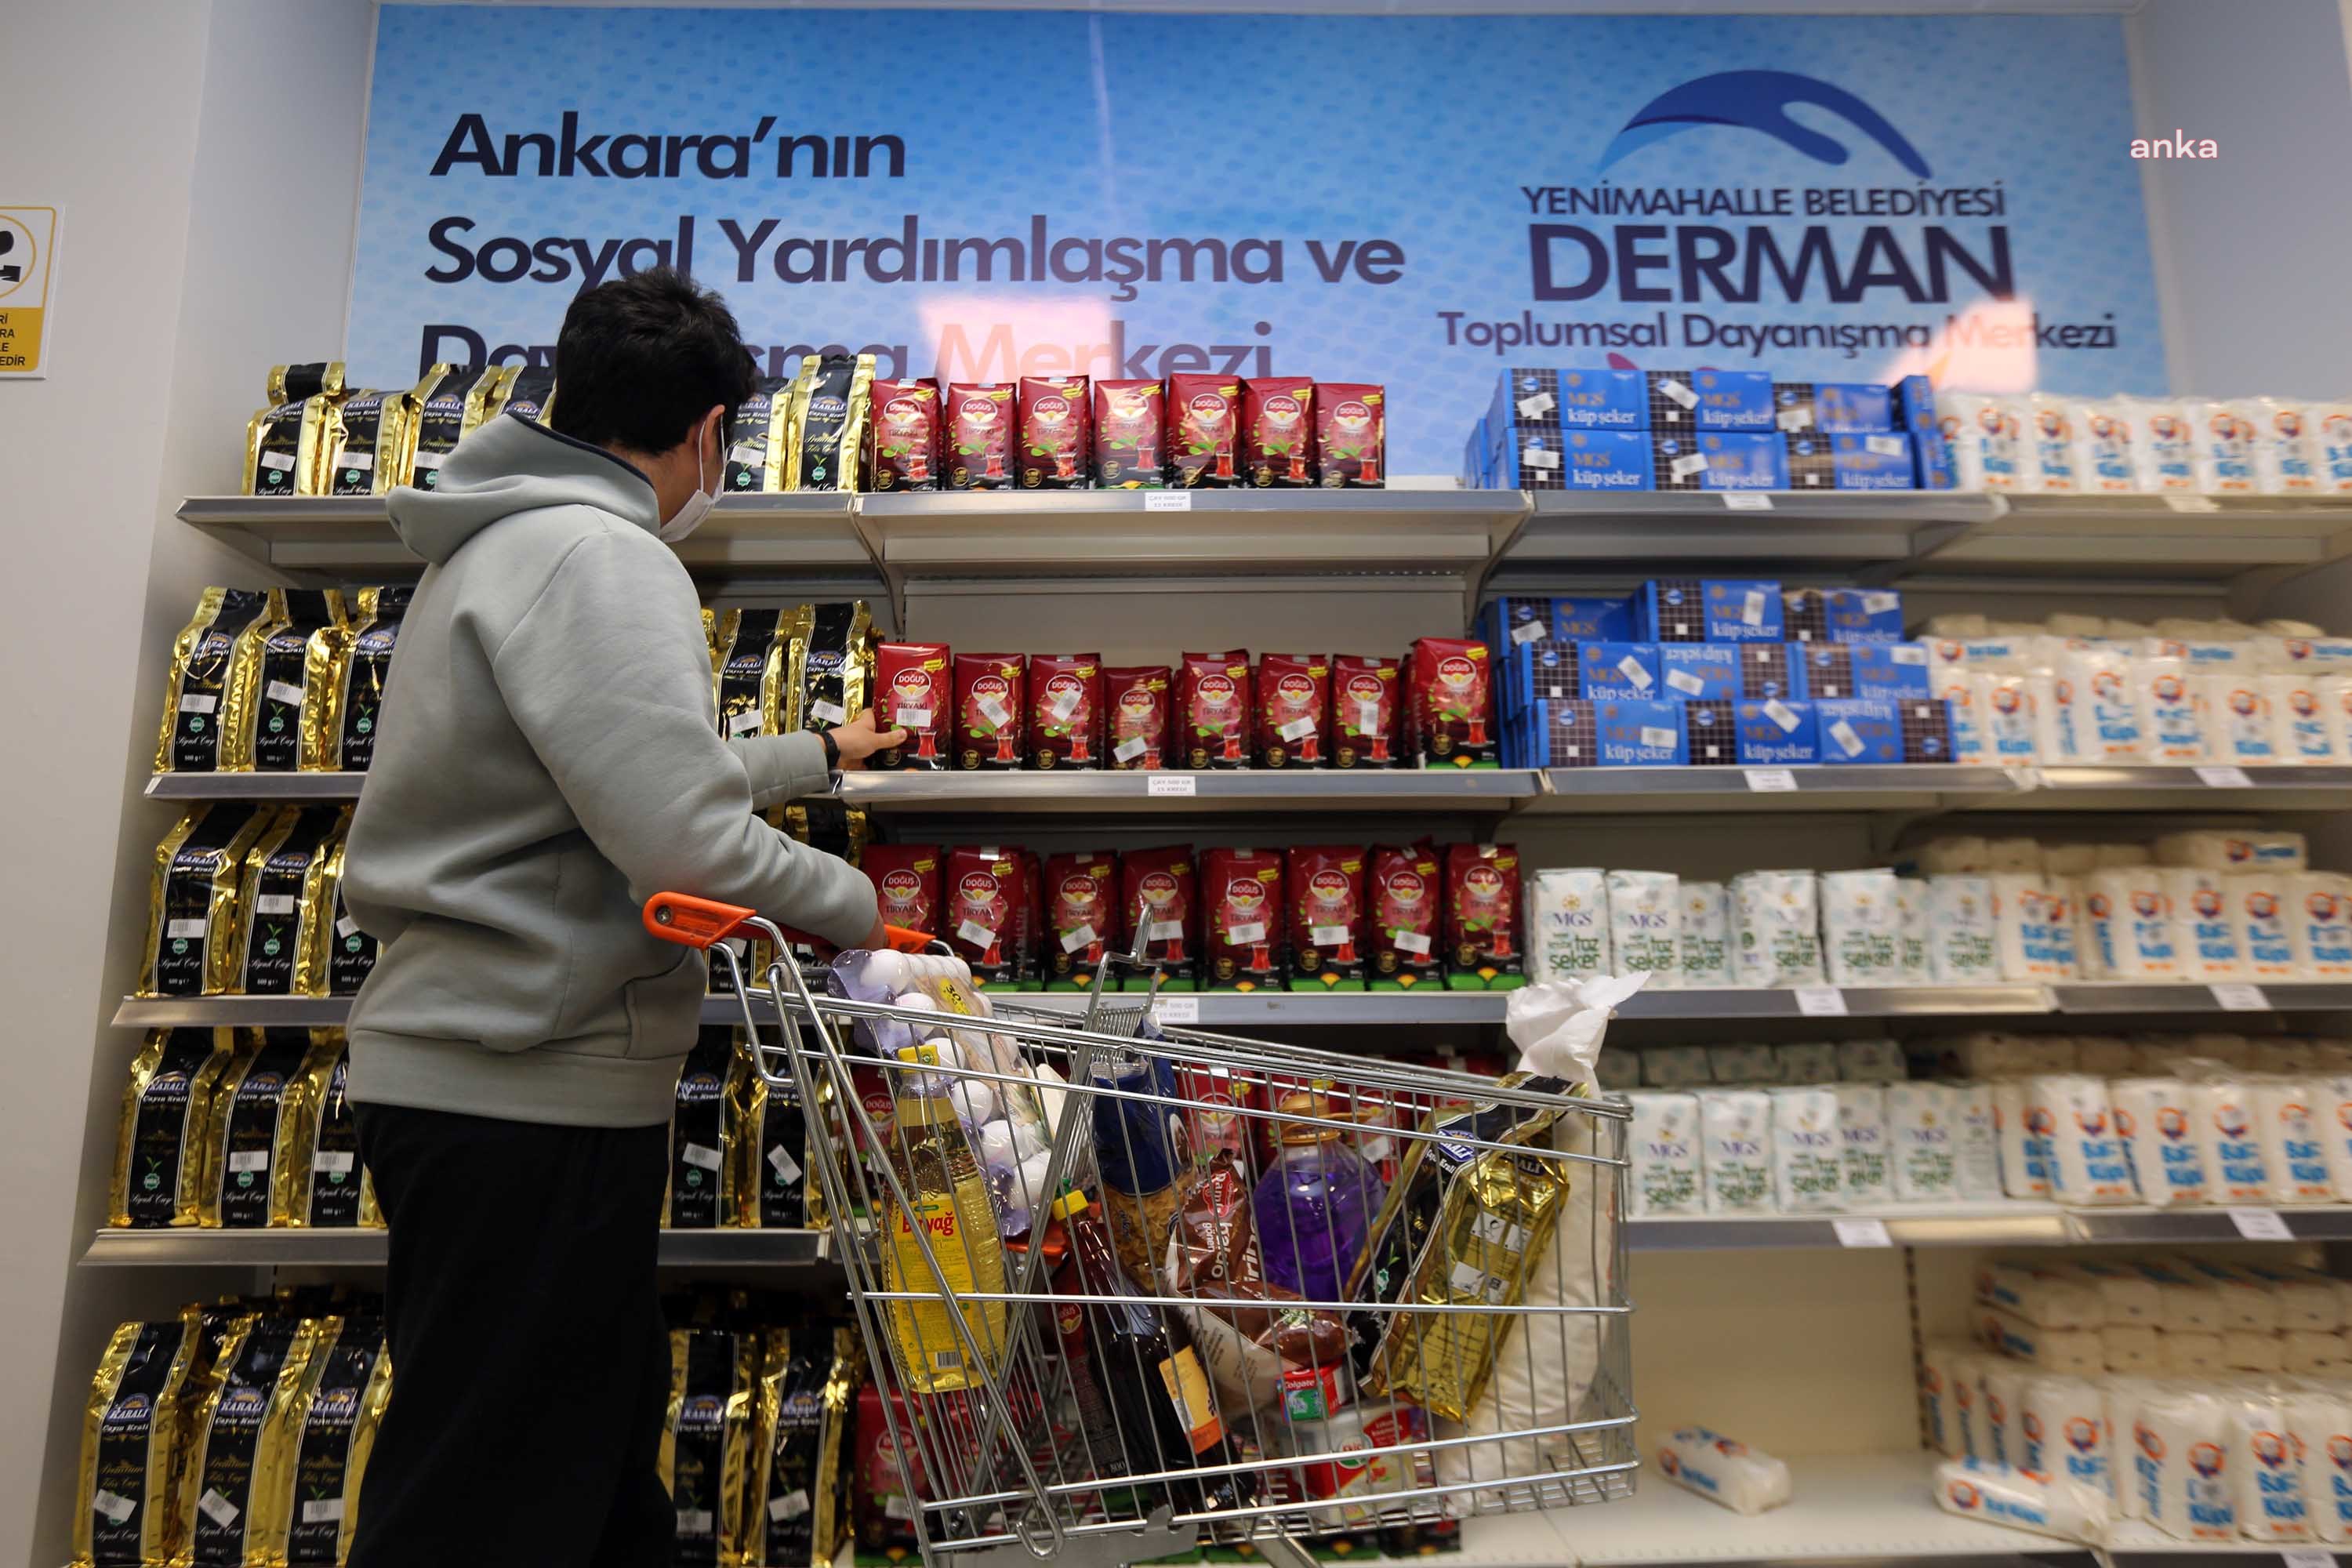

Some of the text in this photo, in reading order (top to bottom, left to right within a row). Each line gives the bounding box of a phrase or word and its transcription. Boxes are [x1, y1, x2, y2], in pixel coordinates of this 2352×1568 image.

[1520, 180, 2005, 216] YENİMAHALLE BELEDİYESİ
[424, 214, 1405, 302] Sosyal Yardımlaşma ve
[1529, 223, 2016, 303] DERMAN
[1438, 310, 2117, 358] Toplumsal Dayanışma Merkezi
[898, 674, 926, 685] DOĞUŞ
[888, 876, 915, 887] DOĞUŞ
[965, 878, 993, 889] DOĞUŞ
[902, 1212, 954, 1236] Byağ
[1286, 1379, 1315, 1389] Colgate
